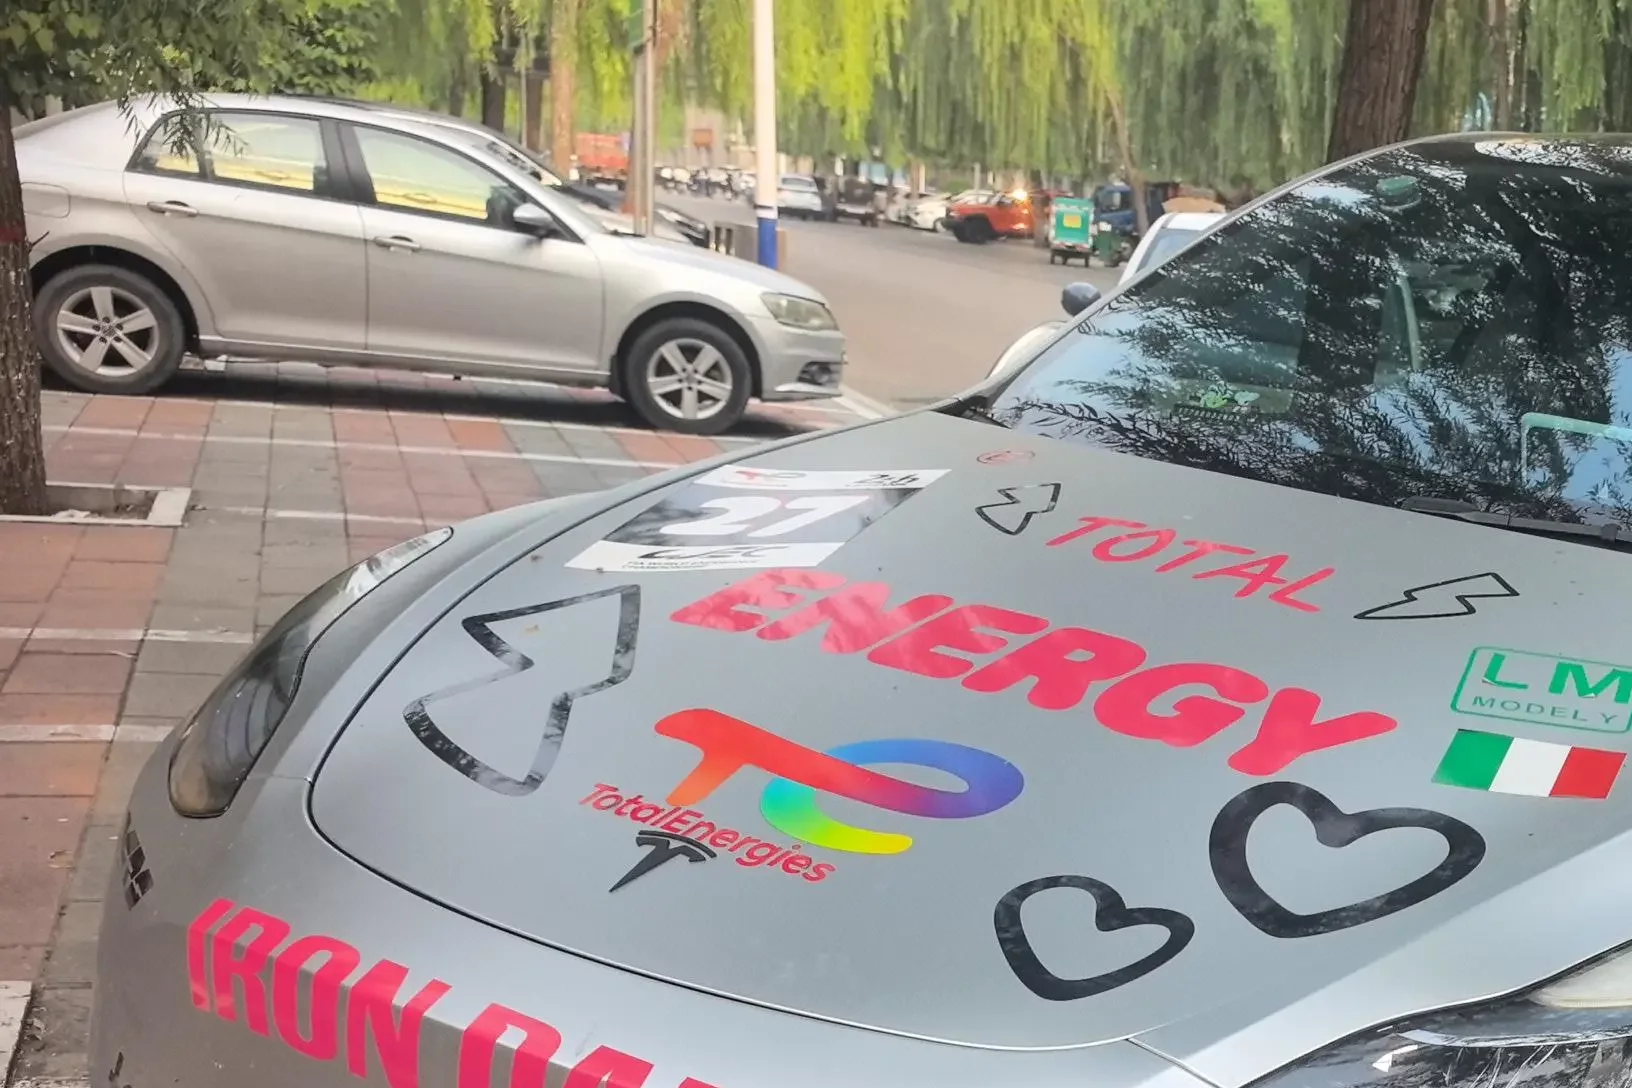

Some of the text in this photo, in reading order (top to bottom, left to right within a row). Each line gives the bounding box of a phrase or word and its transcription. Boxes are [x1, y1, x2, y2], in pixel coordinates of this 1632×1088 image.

[659, 496, 870, 537] 27
[1047, 516, 1336, 613] TOTAL
[670, 567, 1398, 777] ENERGY
[579, 782, 836, 883] TotalEnergies
